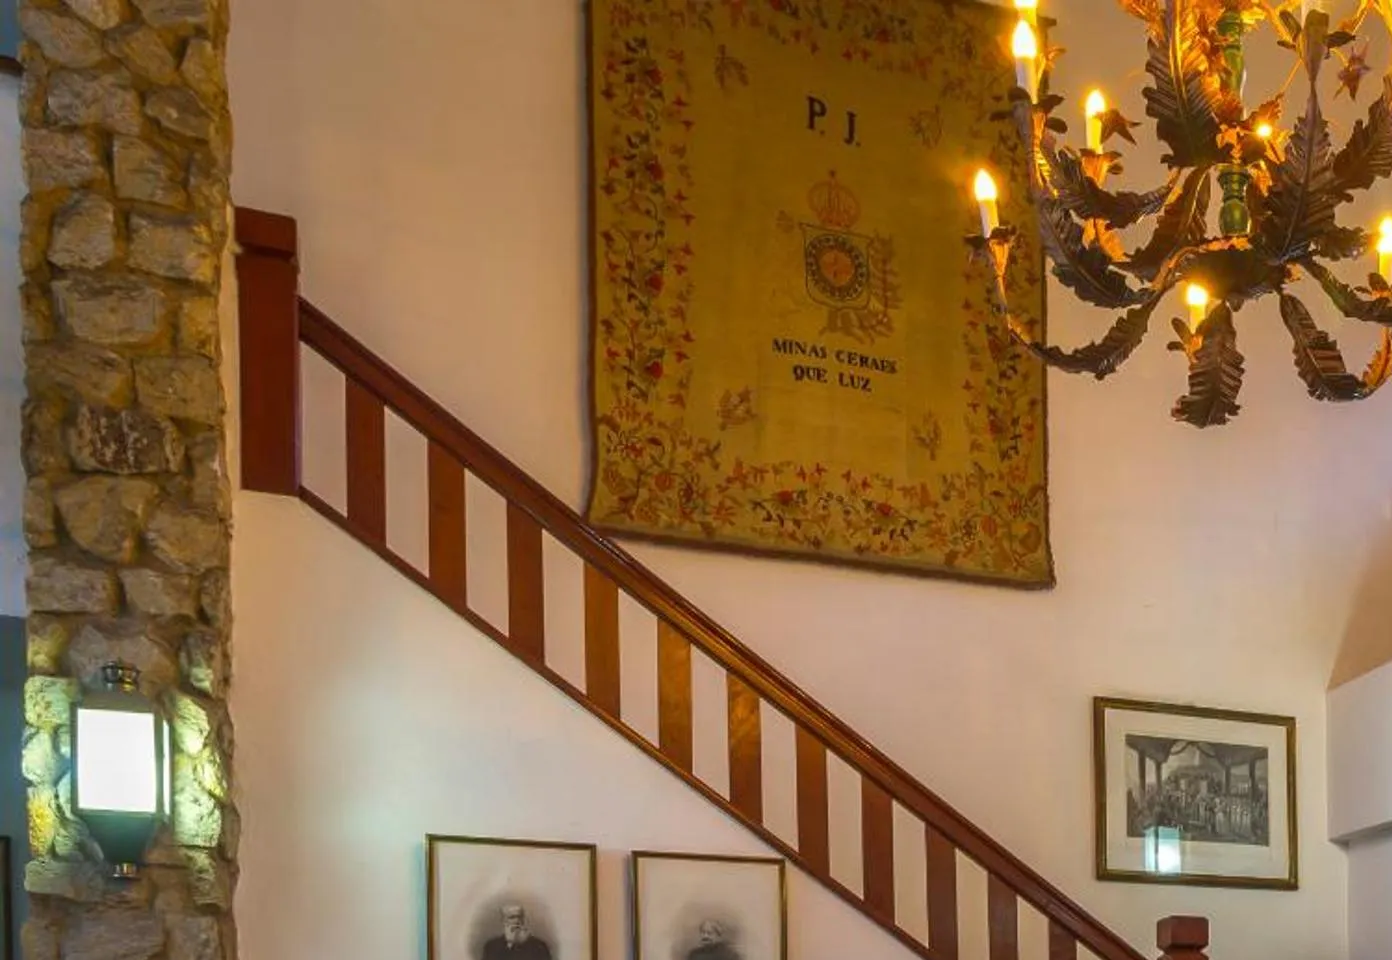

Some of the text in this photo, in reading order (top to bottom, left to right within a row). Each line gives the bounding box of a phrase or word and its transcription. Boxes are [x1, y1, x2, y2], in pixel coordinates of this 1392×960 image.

[772, 338, 827, 360] MINAS
[793, 363, 872, 392] QUE LUZ
